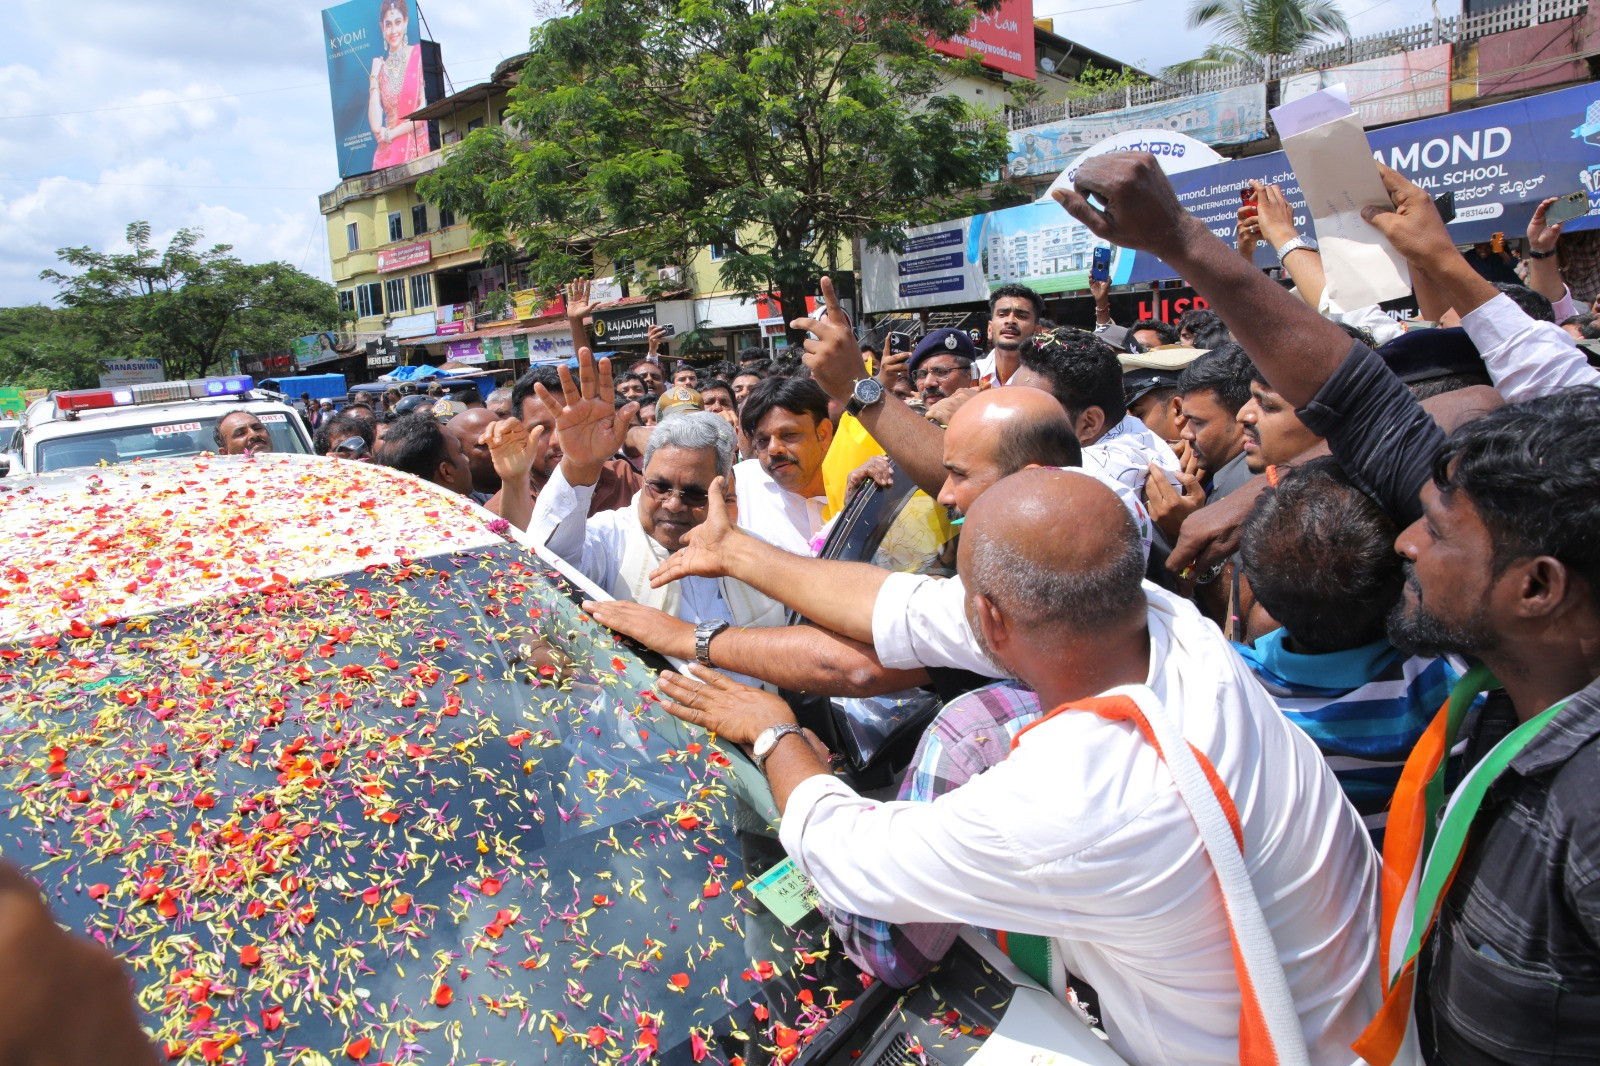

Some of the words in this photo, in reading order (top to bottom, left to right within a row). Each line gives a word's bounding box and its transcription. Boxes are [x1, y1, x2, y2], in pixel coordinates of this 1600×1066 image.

[330, 27, 366, 49] KYOMI
[951, 33, 1022, 62] www.akplywoods.com
[1383, 88, 1445, 116] PARLOUR
[1442, 164, 1508, 185] SCHOOL
[1197, 197, 1242, 211] INTERNATIONA
[1459, 206, 1495, 218] #831440
[596, 290, 612, 299] CENTRE
[607, 317, 654, 334] RAJADHANI
[382, 354, 397, 364] WEAR
[106, 363, 159, 372] MANASWINI
[154, 421, 201, 435] POLICE
